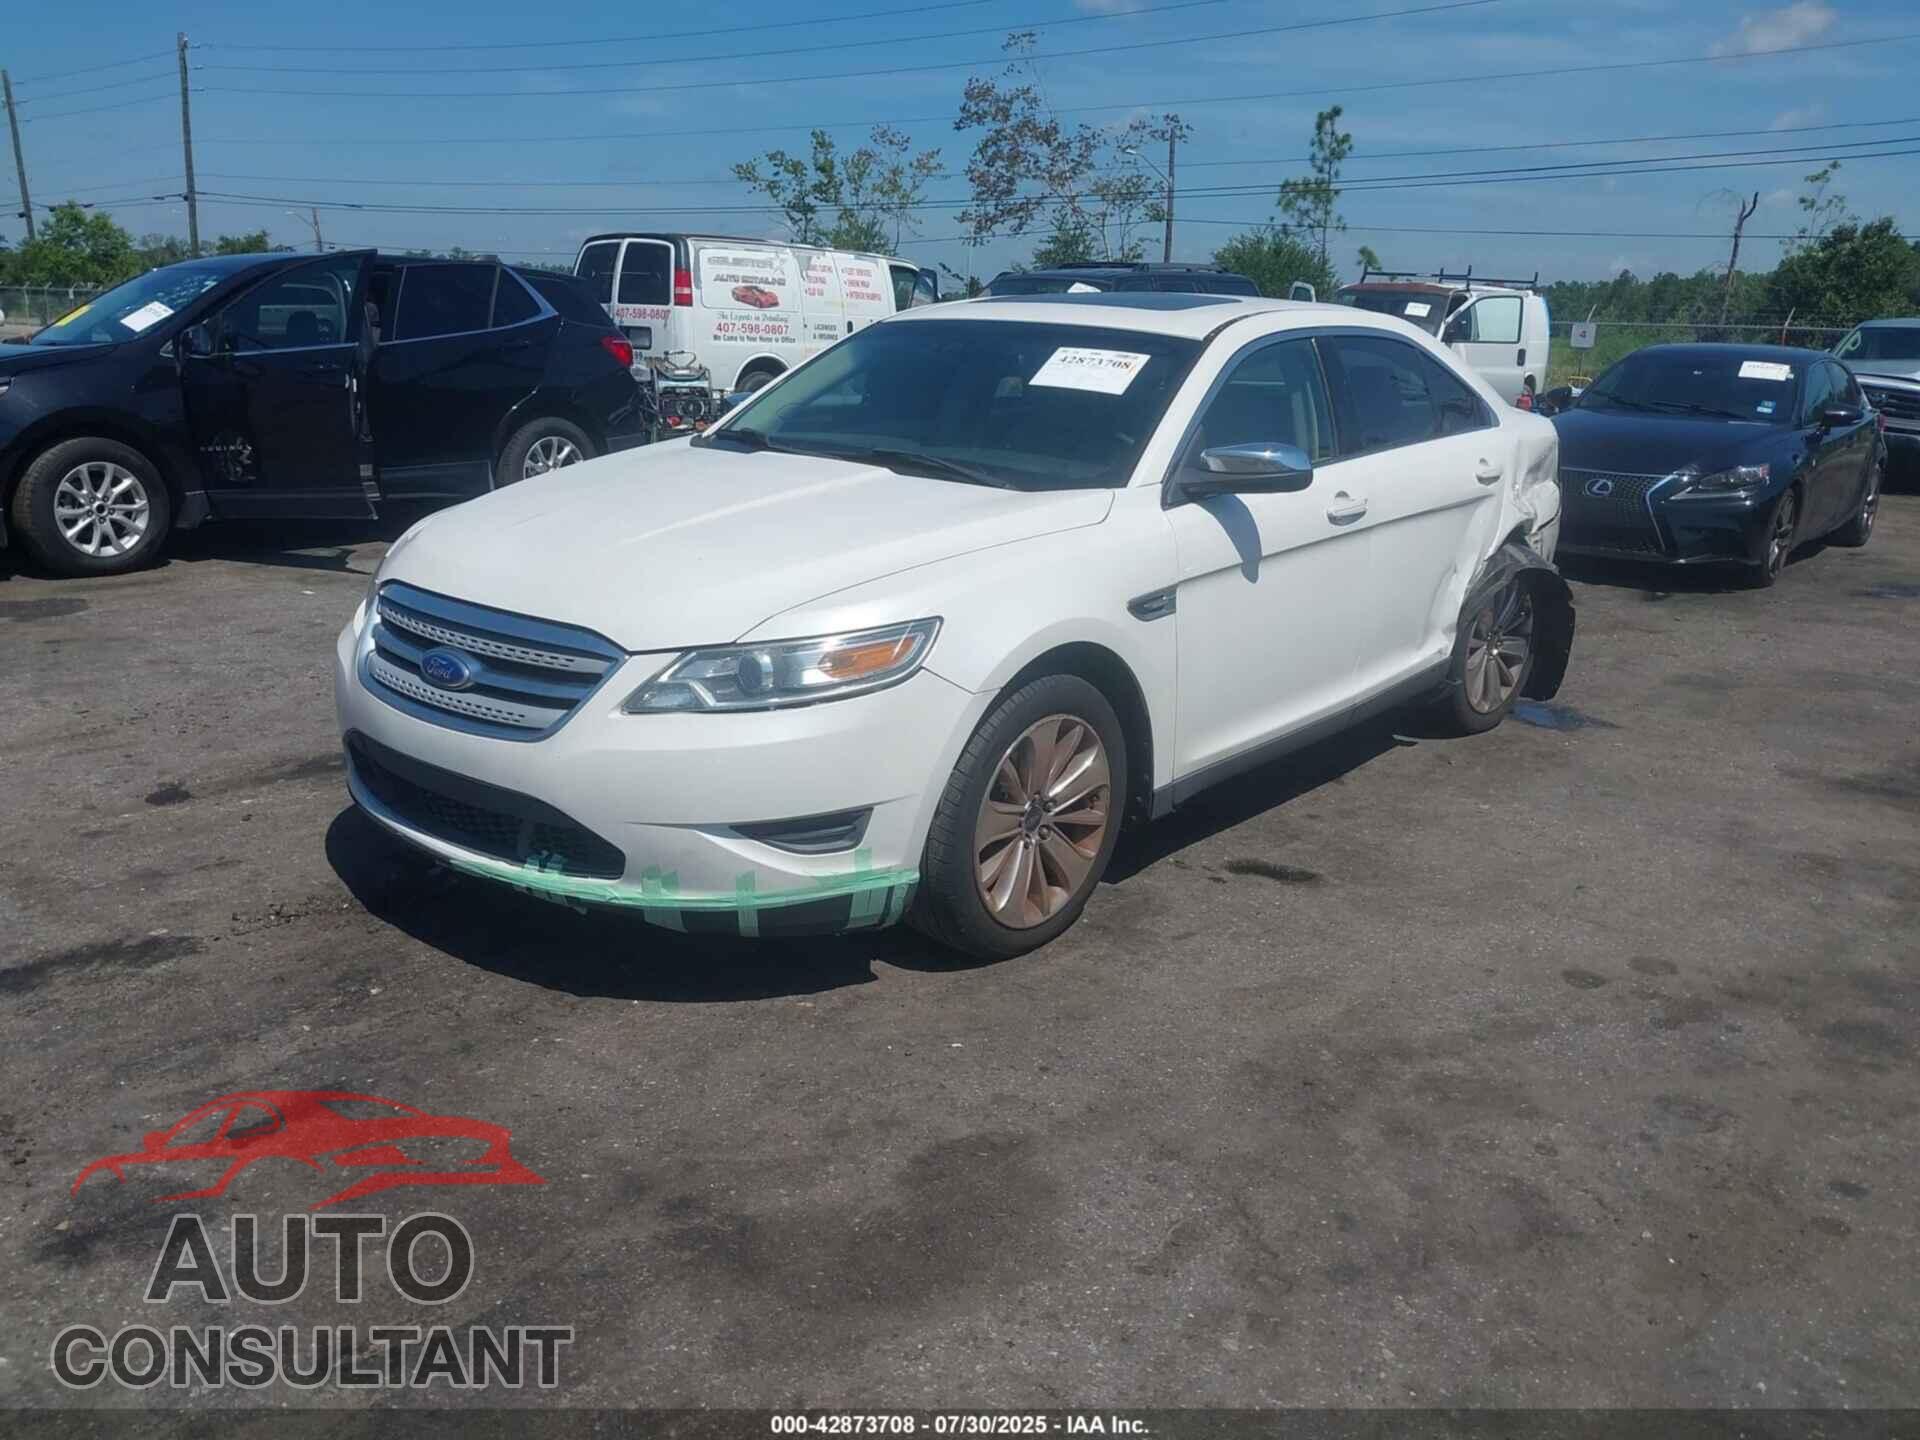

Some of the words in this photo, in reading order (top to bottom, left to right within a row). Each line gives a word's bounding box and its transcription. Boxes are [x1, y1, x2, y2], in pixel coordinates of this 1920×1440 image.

[616, 307, 672, 320] 407-598-0807
[716, 322, 790, 335] 407-598-0807
[781, 336, 796, 344] Office
[426, 656, 453, 681] Ford
